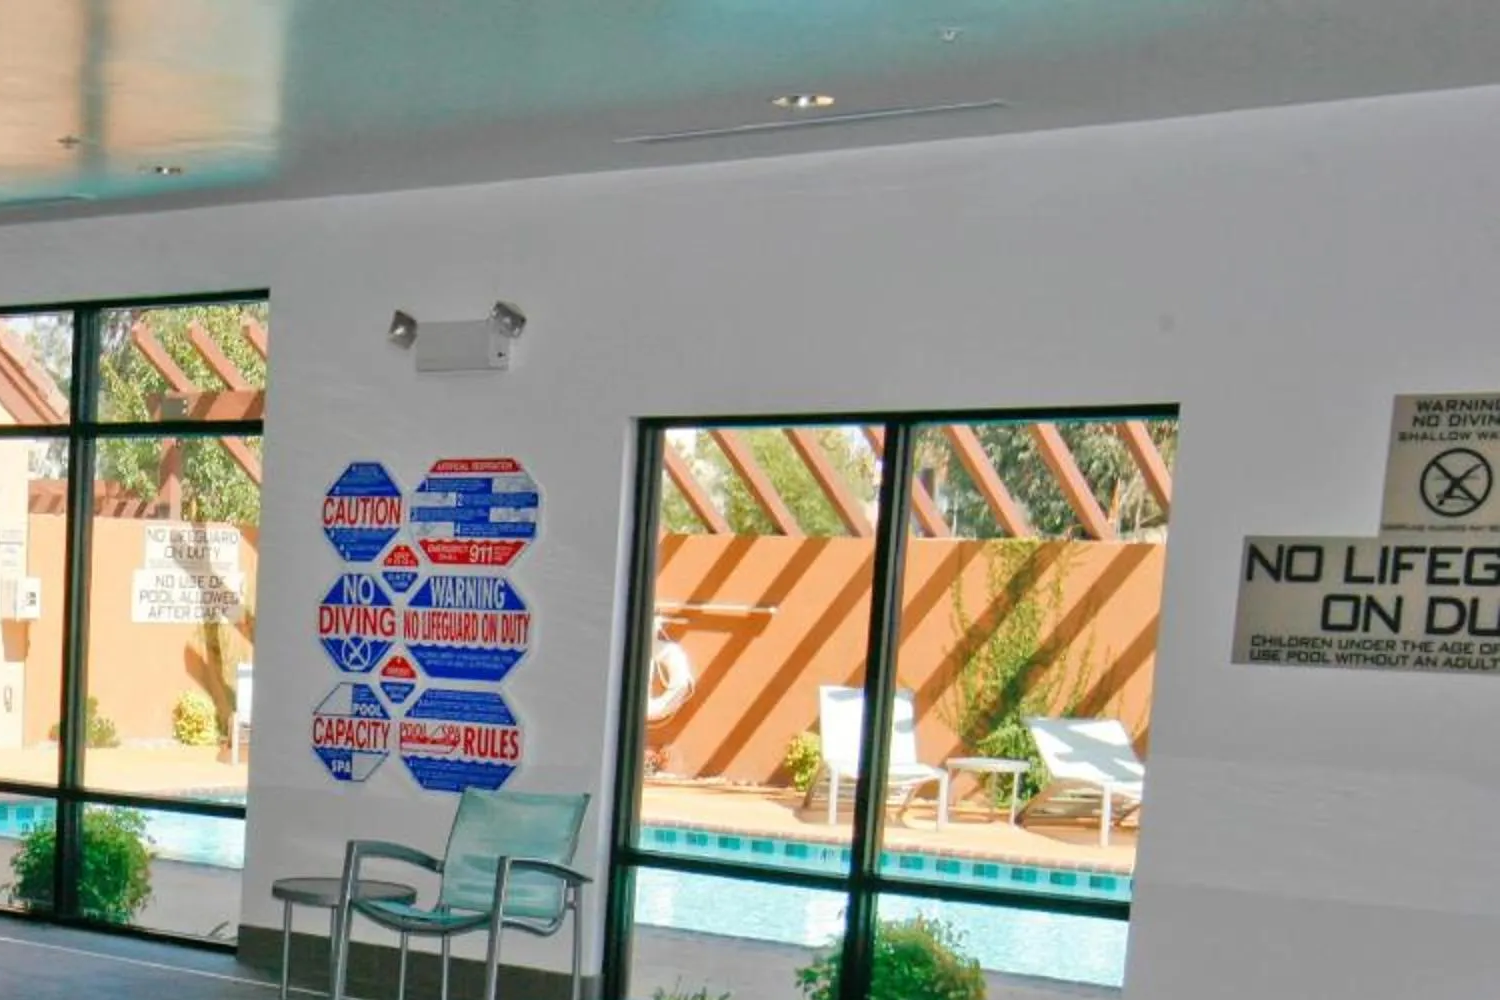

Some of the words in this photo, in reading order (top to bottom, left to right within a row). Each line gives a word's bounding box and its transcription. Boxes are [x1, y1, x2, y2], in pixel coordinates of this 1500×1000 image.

[1416, 400, 1500, 412] WARNIN
[1412, 415, 1438, 427] NO
[1398, 432, 1472, 441] SHALLOW
[323, 497, 400, 525] CAUTION
[469, 544, 493, 563] 911
[1246, 544, 1324, 582] NO
[155, 576, 175, 588] NO
[343, 575, 375, 605] NO
[431, 576, 506, 609] WARNING
[148, 606, 191, 619] AFTER
[319, 605, 396, 637] DIVING
[1321, 594, 1404, 634] ON
[404, 612, 420, 640] NO
[422, 612, 479, 642] LIFEGUARD
[482, 613, 499, 643] ON
[501, 613, 531, 645] DUTY
[1252, 634, 1333, 649] CHILDREN
[1338, 639, 1396, 651] UNDER
[1401, 640, 1435, 653] THE
[1440, 642, 1473, 655] AGE
[1250, 650, 1281, 661] USE
[1286, 651, 1331, 664] POOL
[1335, 653, 1410, 667] WITHOUT
[1413, 655, 1437, 668] AN
[353, 703, 381, 717] POOL
[312, 718, 391, 748] CAPACITY
[463, 727, 520, 761] RULES
[331, 760, 352, 773] SPA
